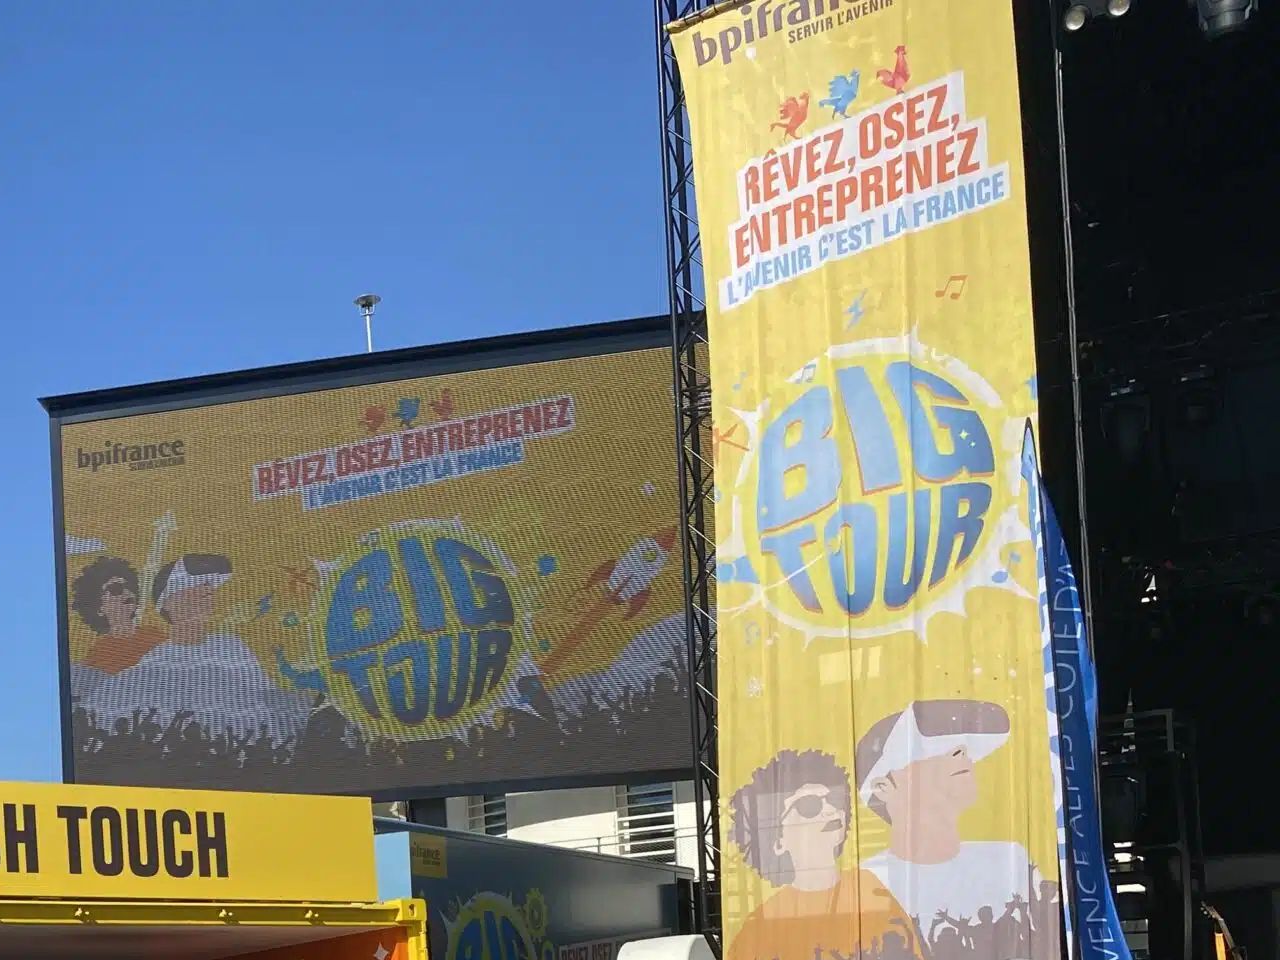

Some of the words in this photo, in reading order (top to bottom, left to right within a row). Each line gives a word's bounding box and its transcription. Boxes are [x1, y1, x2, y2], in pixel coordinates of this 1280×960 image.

[788, 16, 833, 44] SERVIR
[733, 127, 980, 269] ENTREPRENEZ
[744, 128, 857, 212] RÊVEZ,
[857, 83, 960, 160] OSEZ,
[726, 244, 812, 306] L'AVENIR
[818, 218, 875, 262] C'EST
[882, 207, 908, 237] LA
[913, 170, 1005, 228] FRANCE
[77, 440, 185, 472] bpifrance
[402, 397, 572, 462] ENTREPRENEZ
[434, 459, 452, 479] LA
[457, 441, 523, 474] FRANCE
[757, 361, 995, 536] BIG
[325, 535, 514, 656] BIG
[760, 482, 993, 618] TOUR
[330, 629, 514, 725] TOUR
[56, 805, 229, 878] TOUCH
